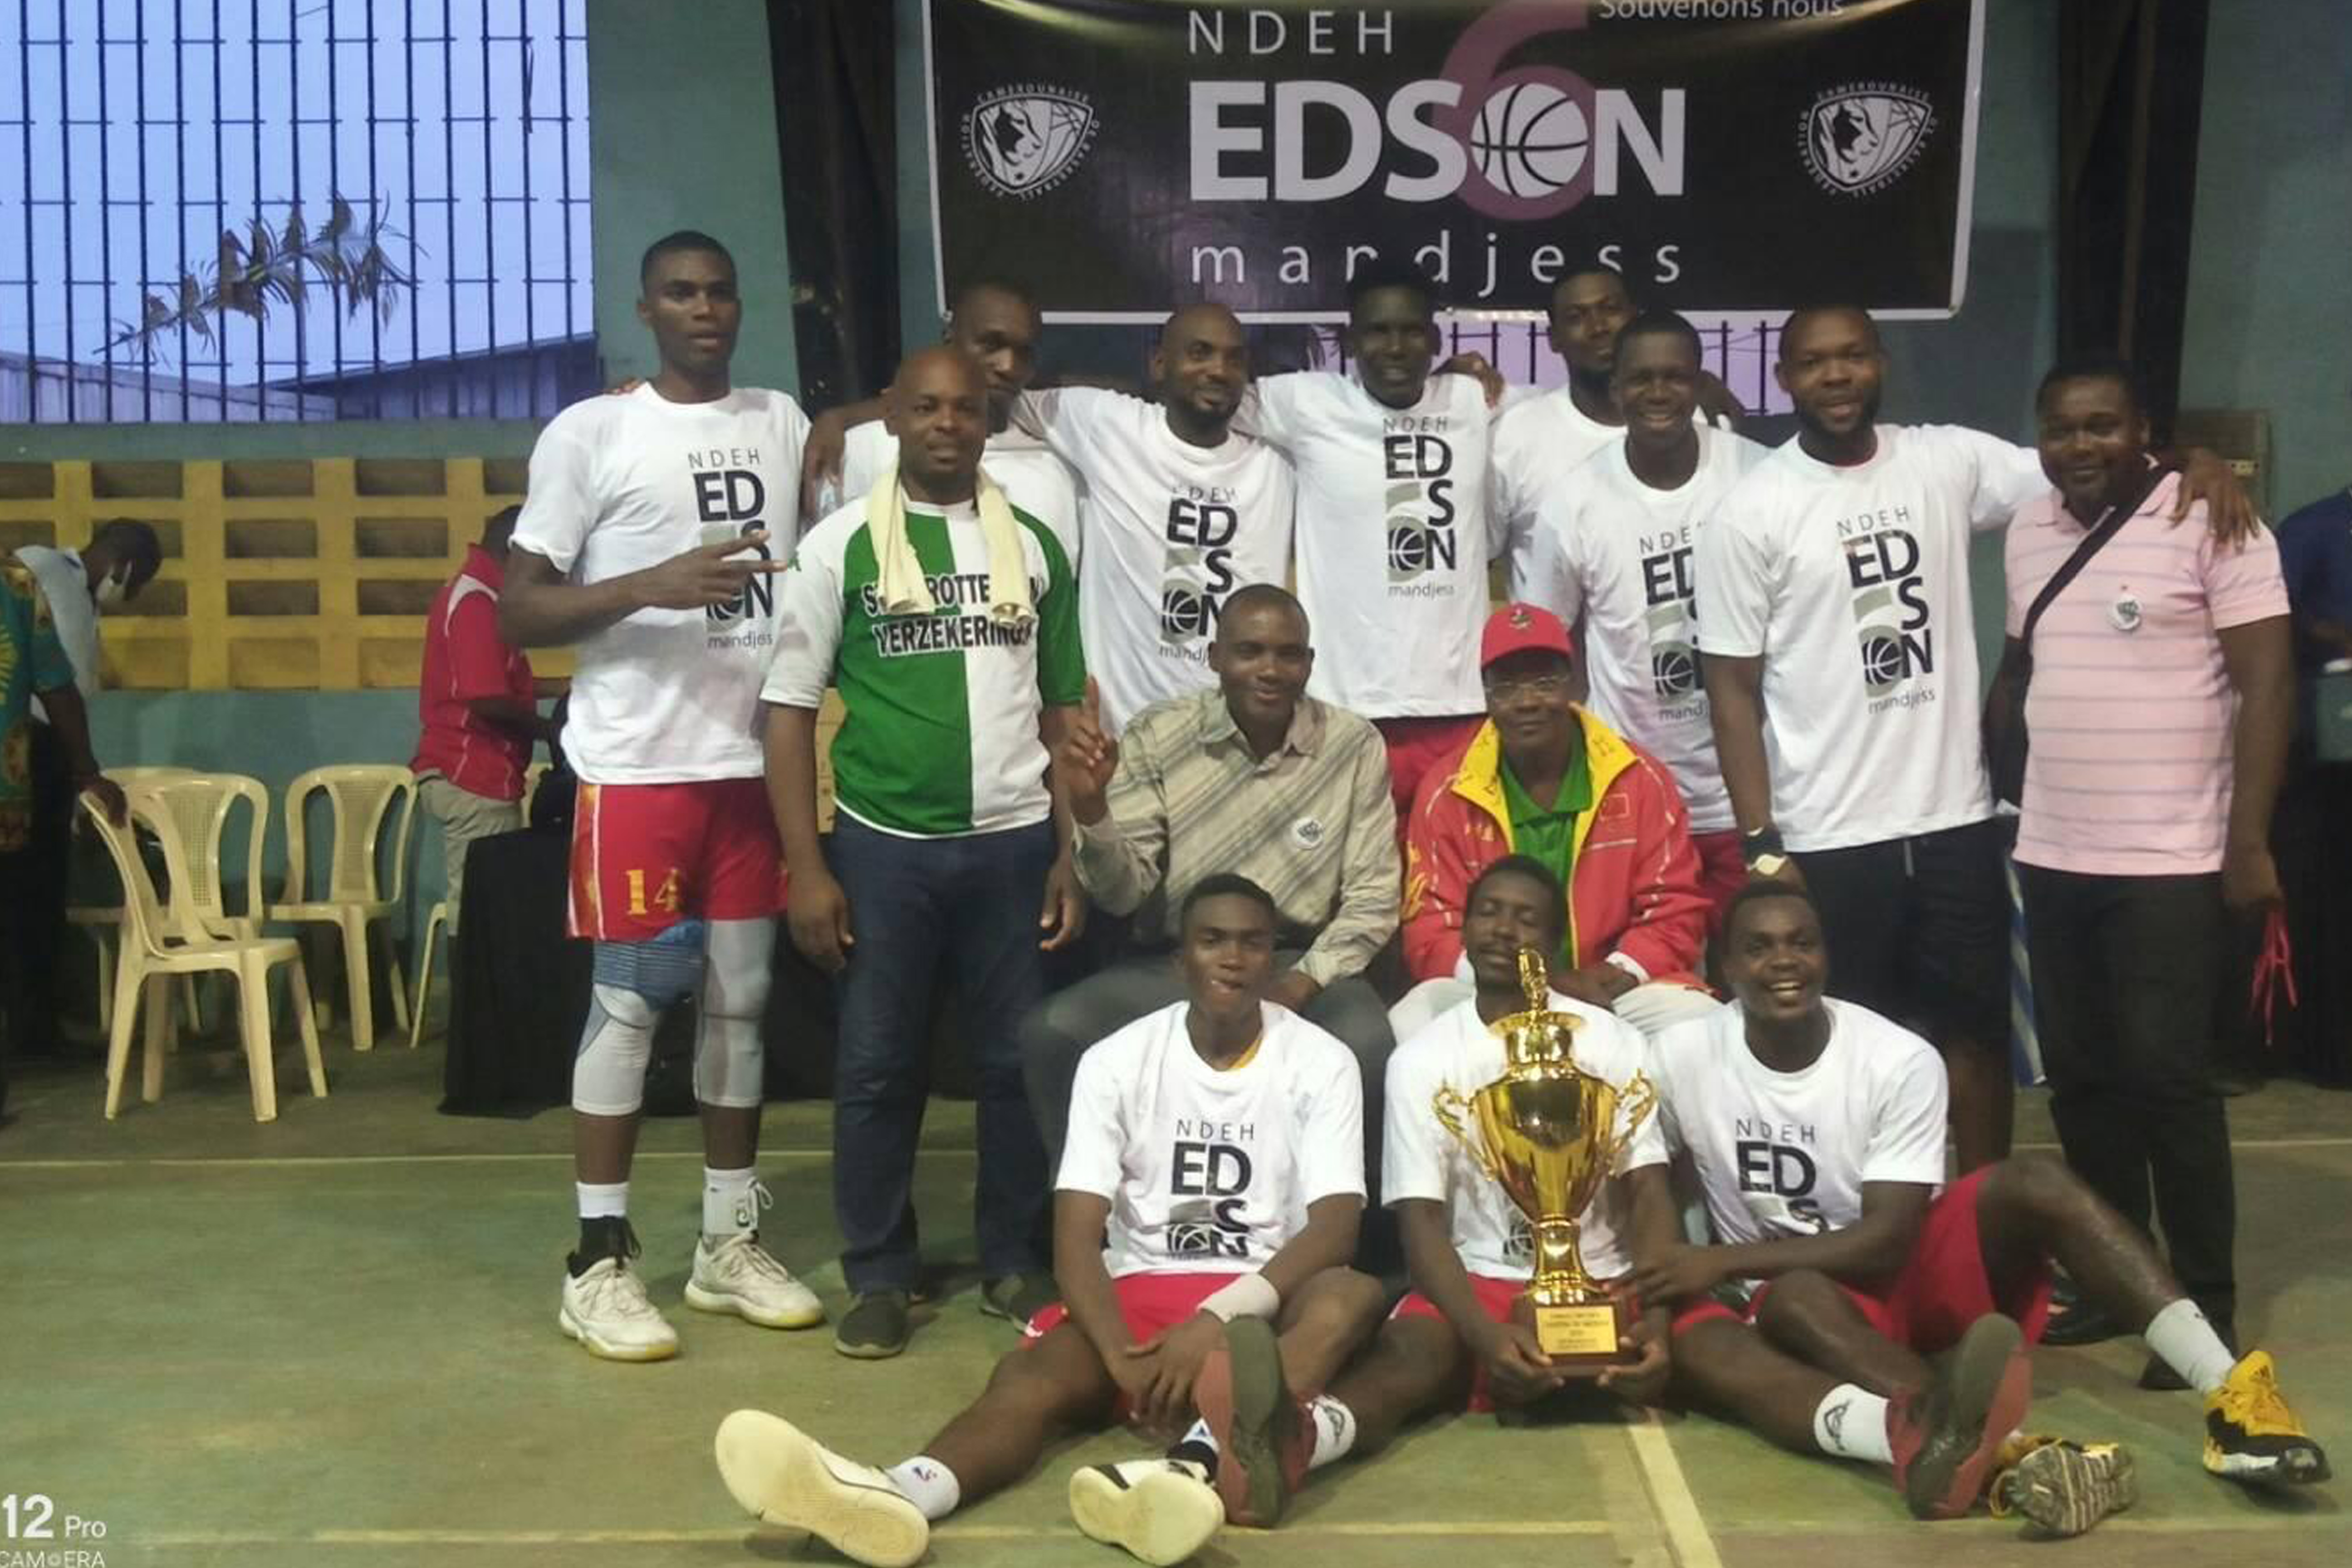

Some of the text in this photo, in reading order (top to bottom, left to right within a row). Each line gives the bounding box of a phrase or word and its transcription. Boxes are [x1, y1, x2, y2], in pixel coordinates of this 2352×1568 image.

[1599, 0, 1764, 19] Souvenons
[1188, 10, 1393, 54] NDEH
[1383, 416, 1449, 433] NDEH
[688, 448, 761, 469] NDEH
[1384, 435, 1452, 479] ED
[693, 470, 765, 522] ED
[1167, 498, 1238, 546] ED
[1837, 506, 1911, 537] NDEH
[1843, 529, 1920, 588] ED
[626, 867, 681, 915] 14
[1176, 1119, 1255, 1141] NDEH
[1736, 1118, 1815, 1143] NDEH
[1170, 1141, 1253, 1196] ED
[1736, 1141, 1817, 1198] ED
